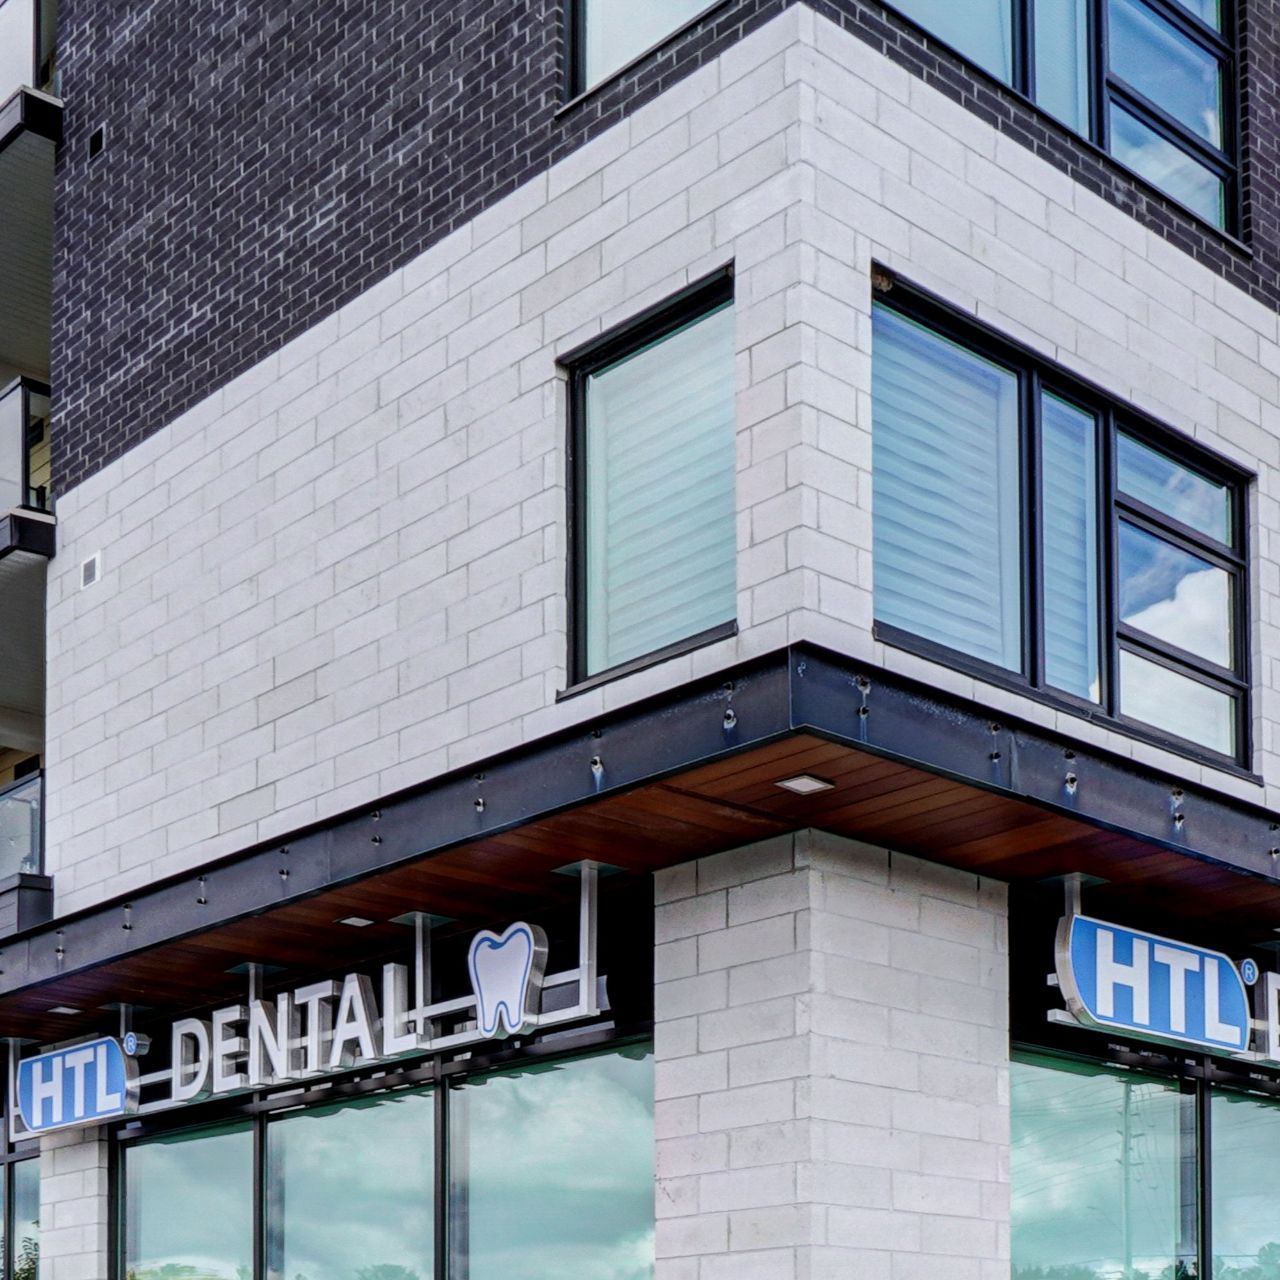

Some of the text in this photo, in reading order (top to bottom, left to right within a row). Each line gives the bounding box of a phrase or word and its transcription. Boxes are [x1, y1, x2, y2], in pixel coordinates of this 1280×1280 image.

[32, 962, 419, 1128] HTL DENTAL
[1097, 928, 1241, 1046] HTL
